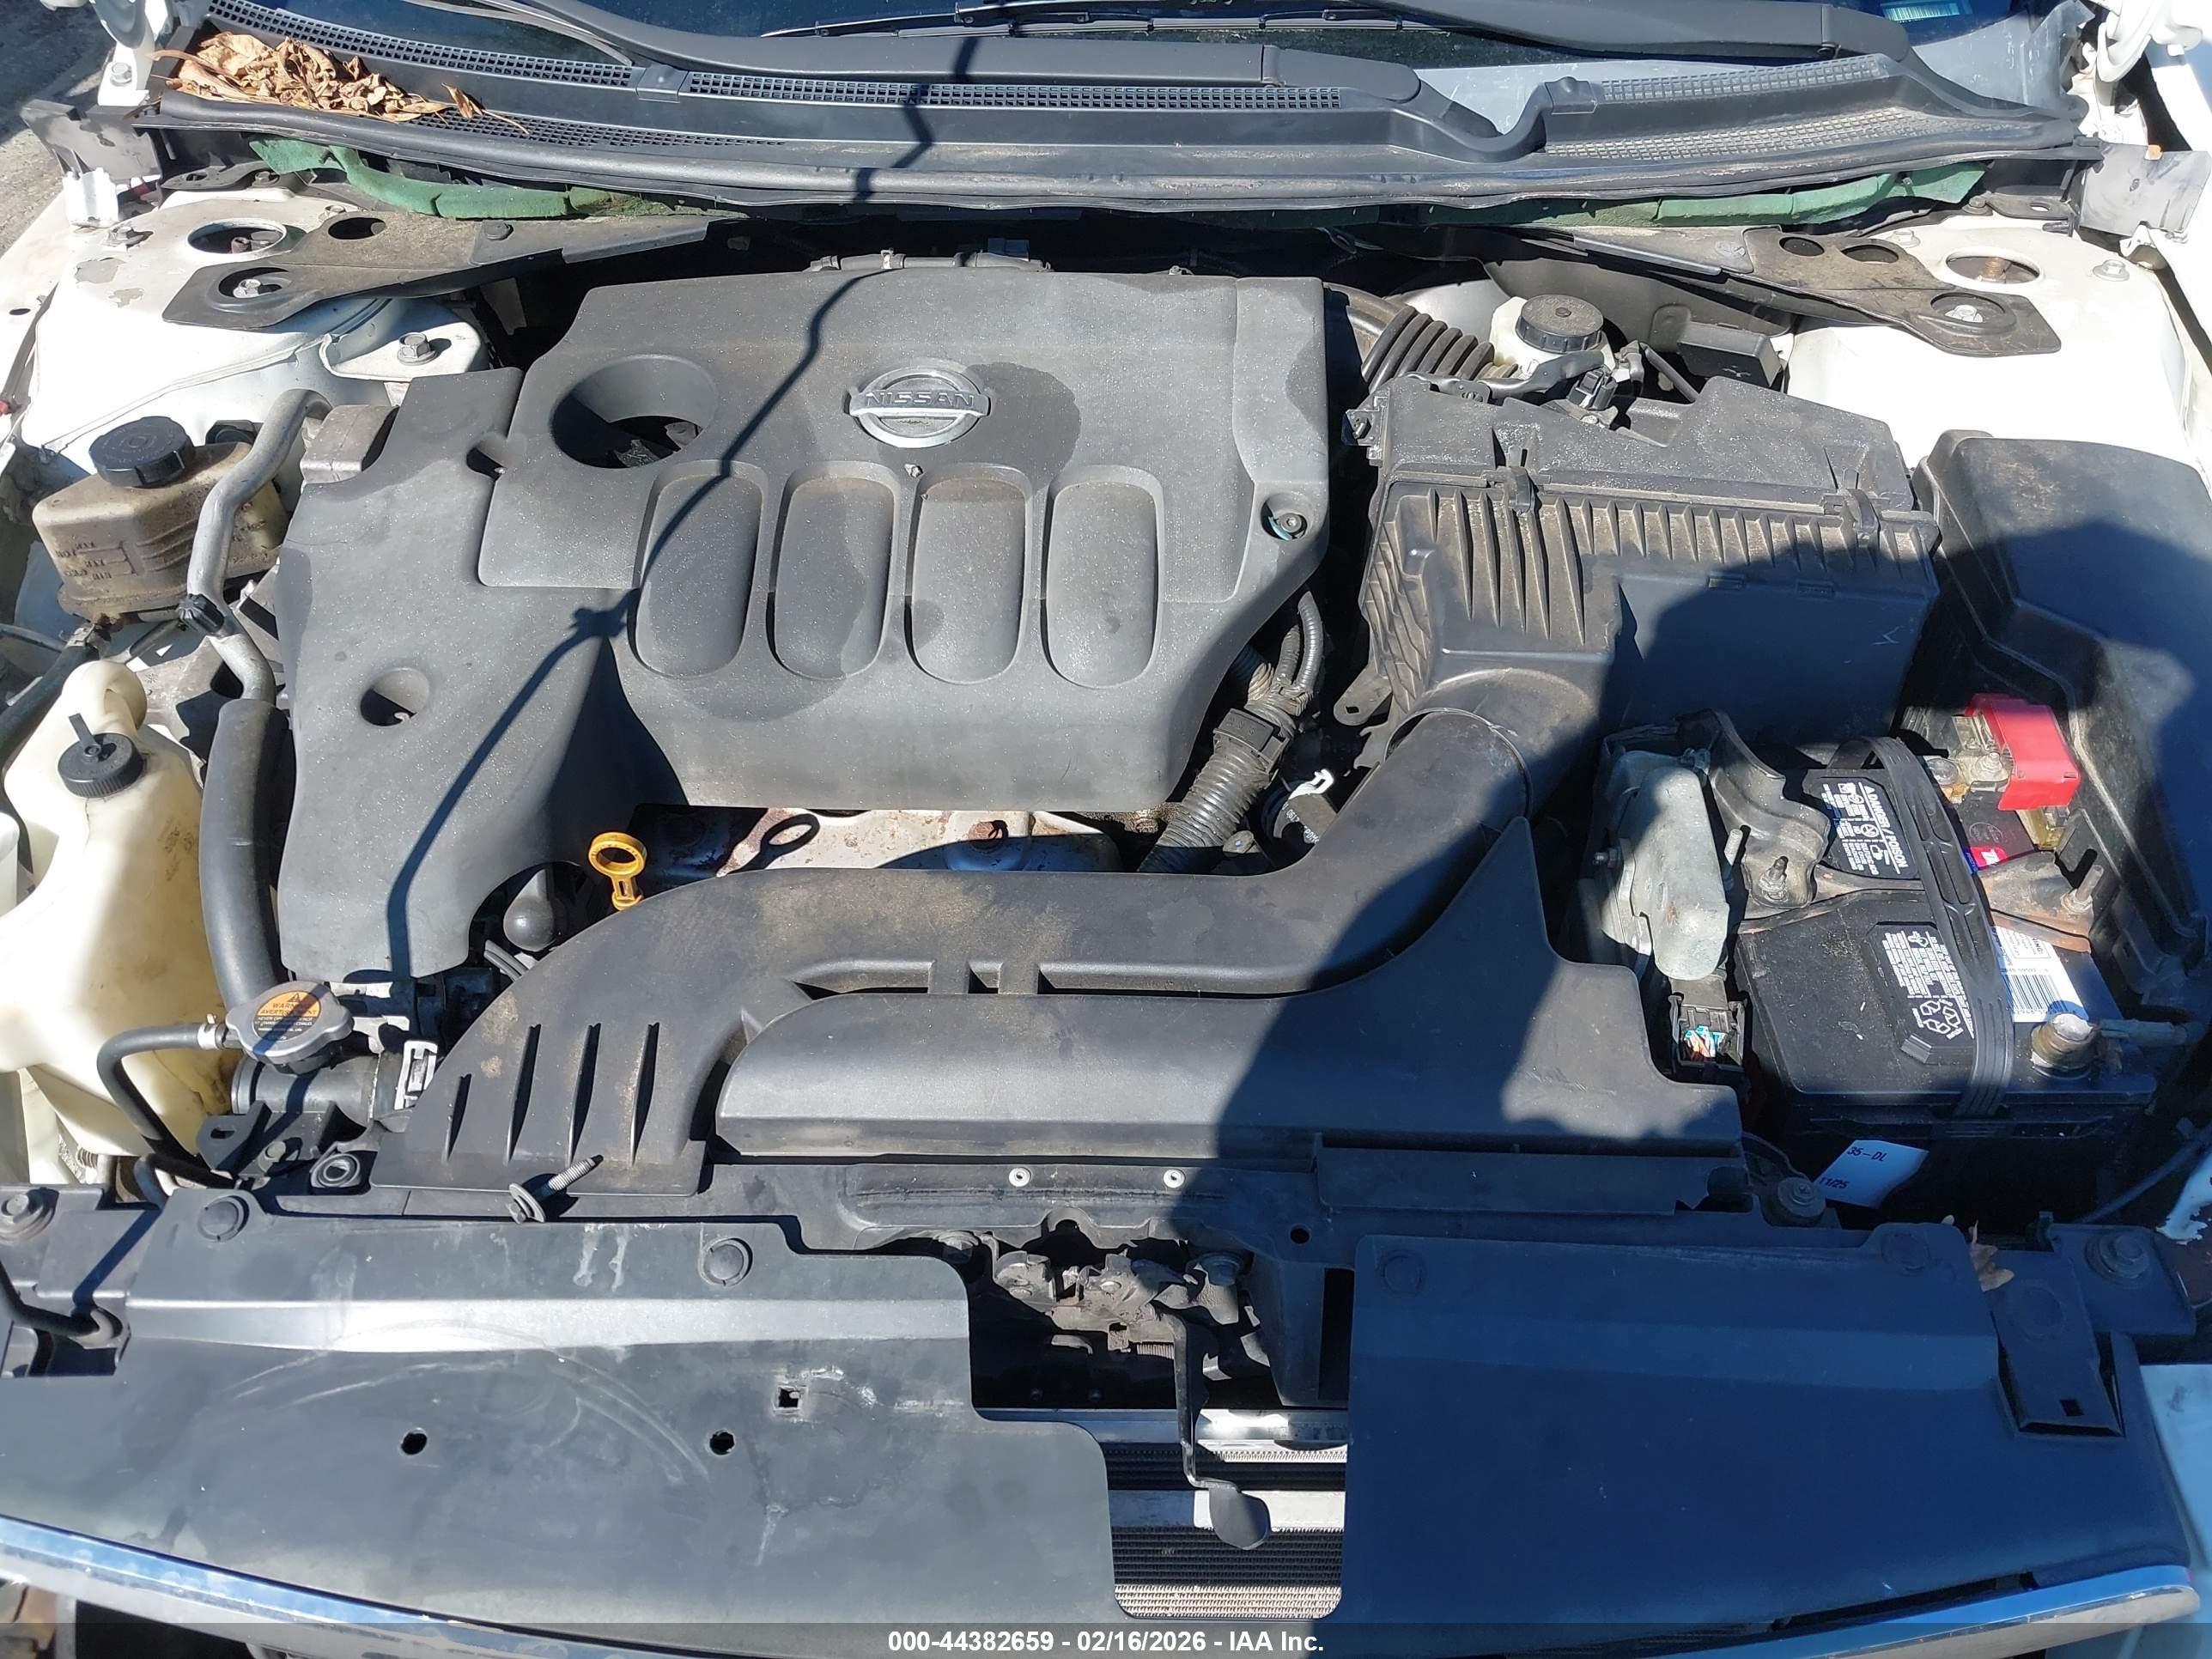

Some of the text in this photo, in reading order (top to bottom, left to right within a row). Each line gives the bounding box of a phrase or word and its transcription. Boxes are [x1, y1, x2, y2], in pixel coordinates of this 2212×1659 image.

[865, 392, 975, 407] NISSAN
[1869, 793, 1890, 829] DANGER
[1885, 835, 1909, 867] POISON
